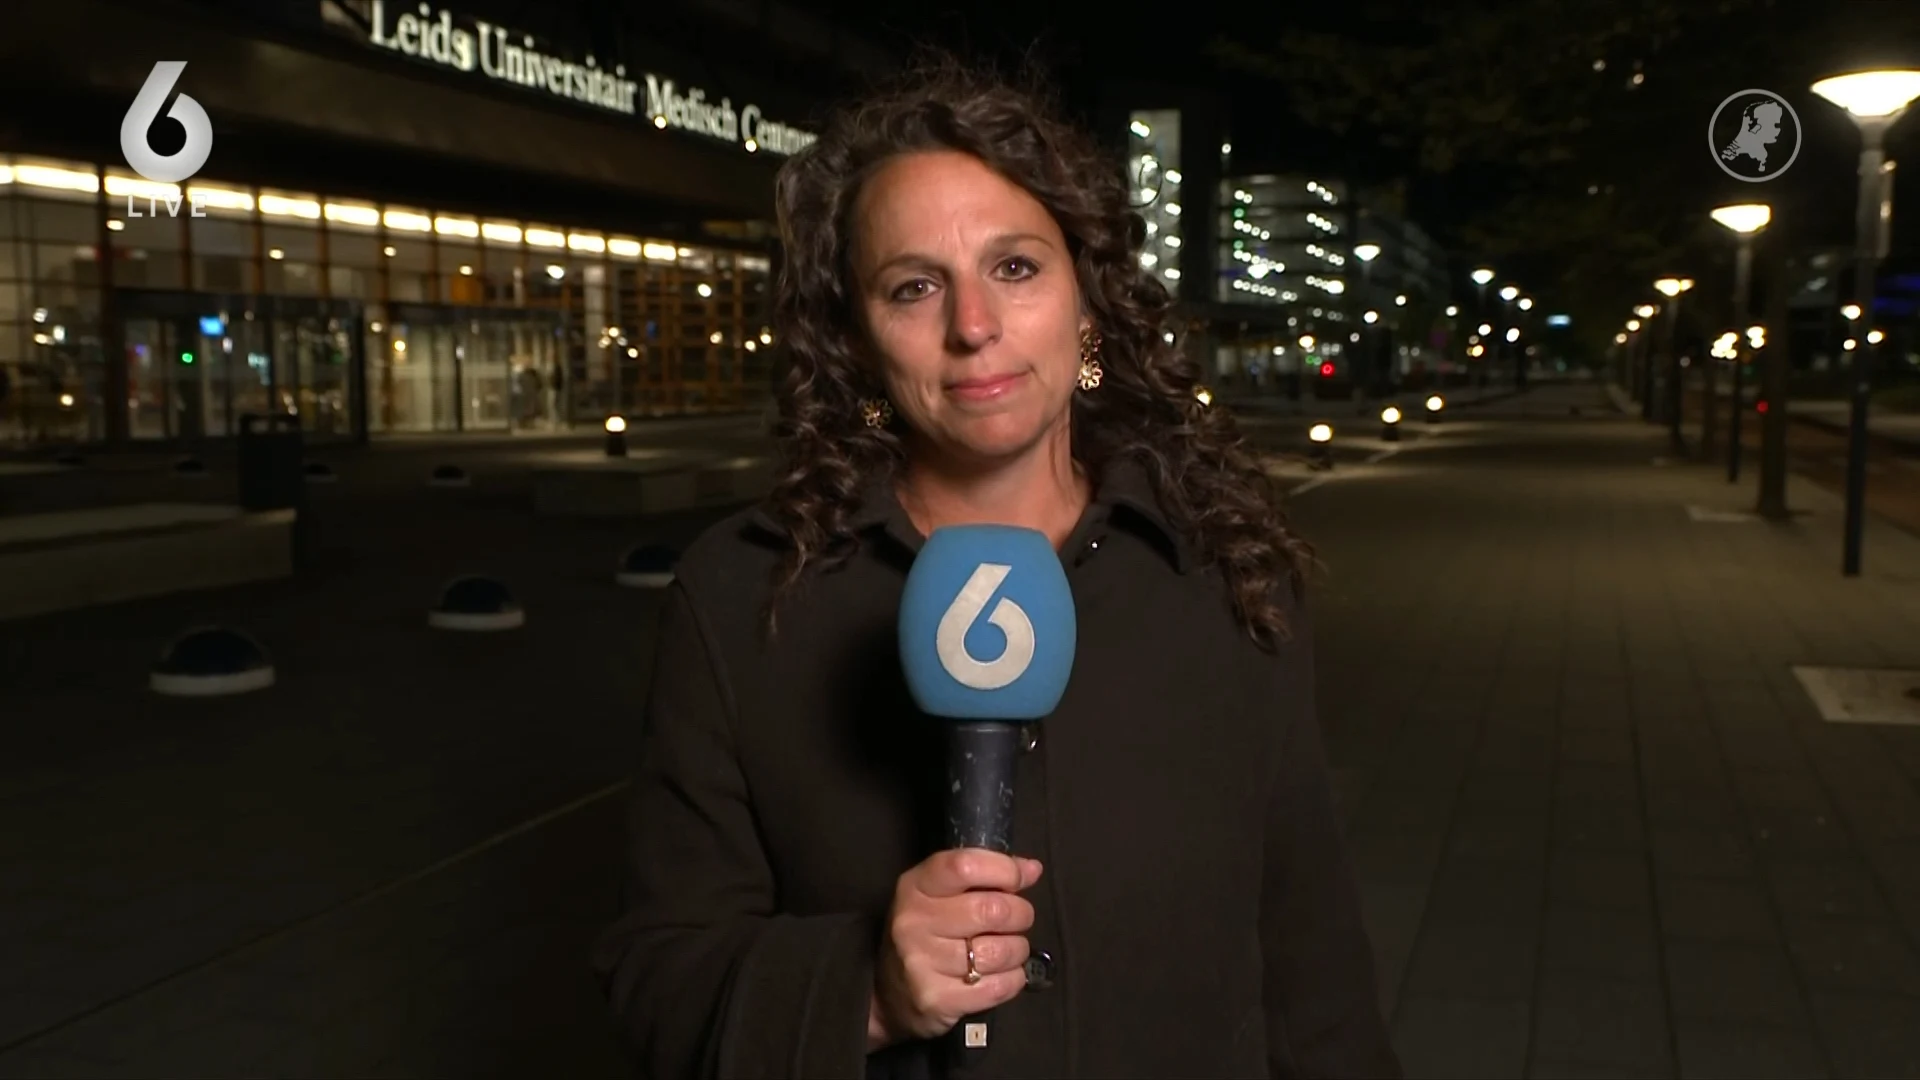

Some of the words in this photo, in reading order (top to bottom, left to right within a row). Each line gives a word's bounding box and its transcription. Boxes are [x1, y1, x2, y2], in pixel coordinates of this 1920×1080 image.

[369, 0, 474, 72] Leids
[476, 20, 636, 114] Universitair
[645, 73, 738, 142] Medisch
[936, 562, 1035, 690] 6
